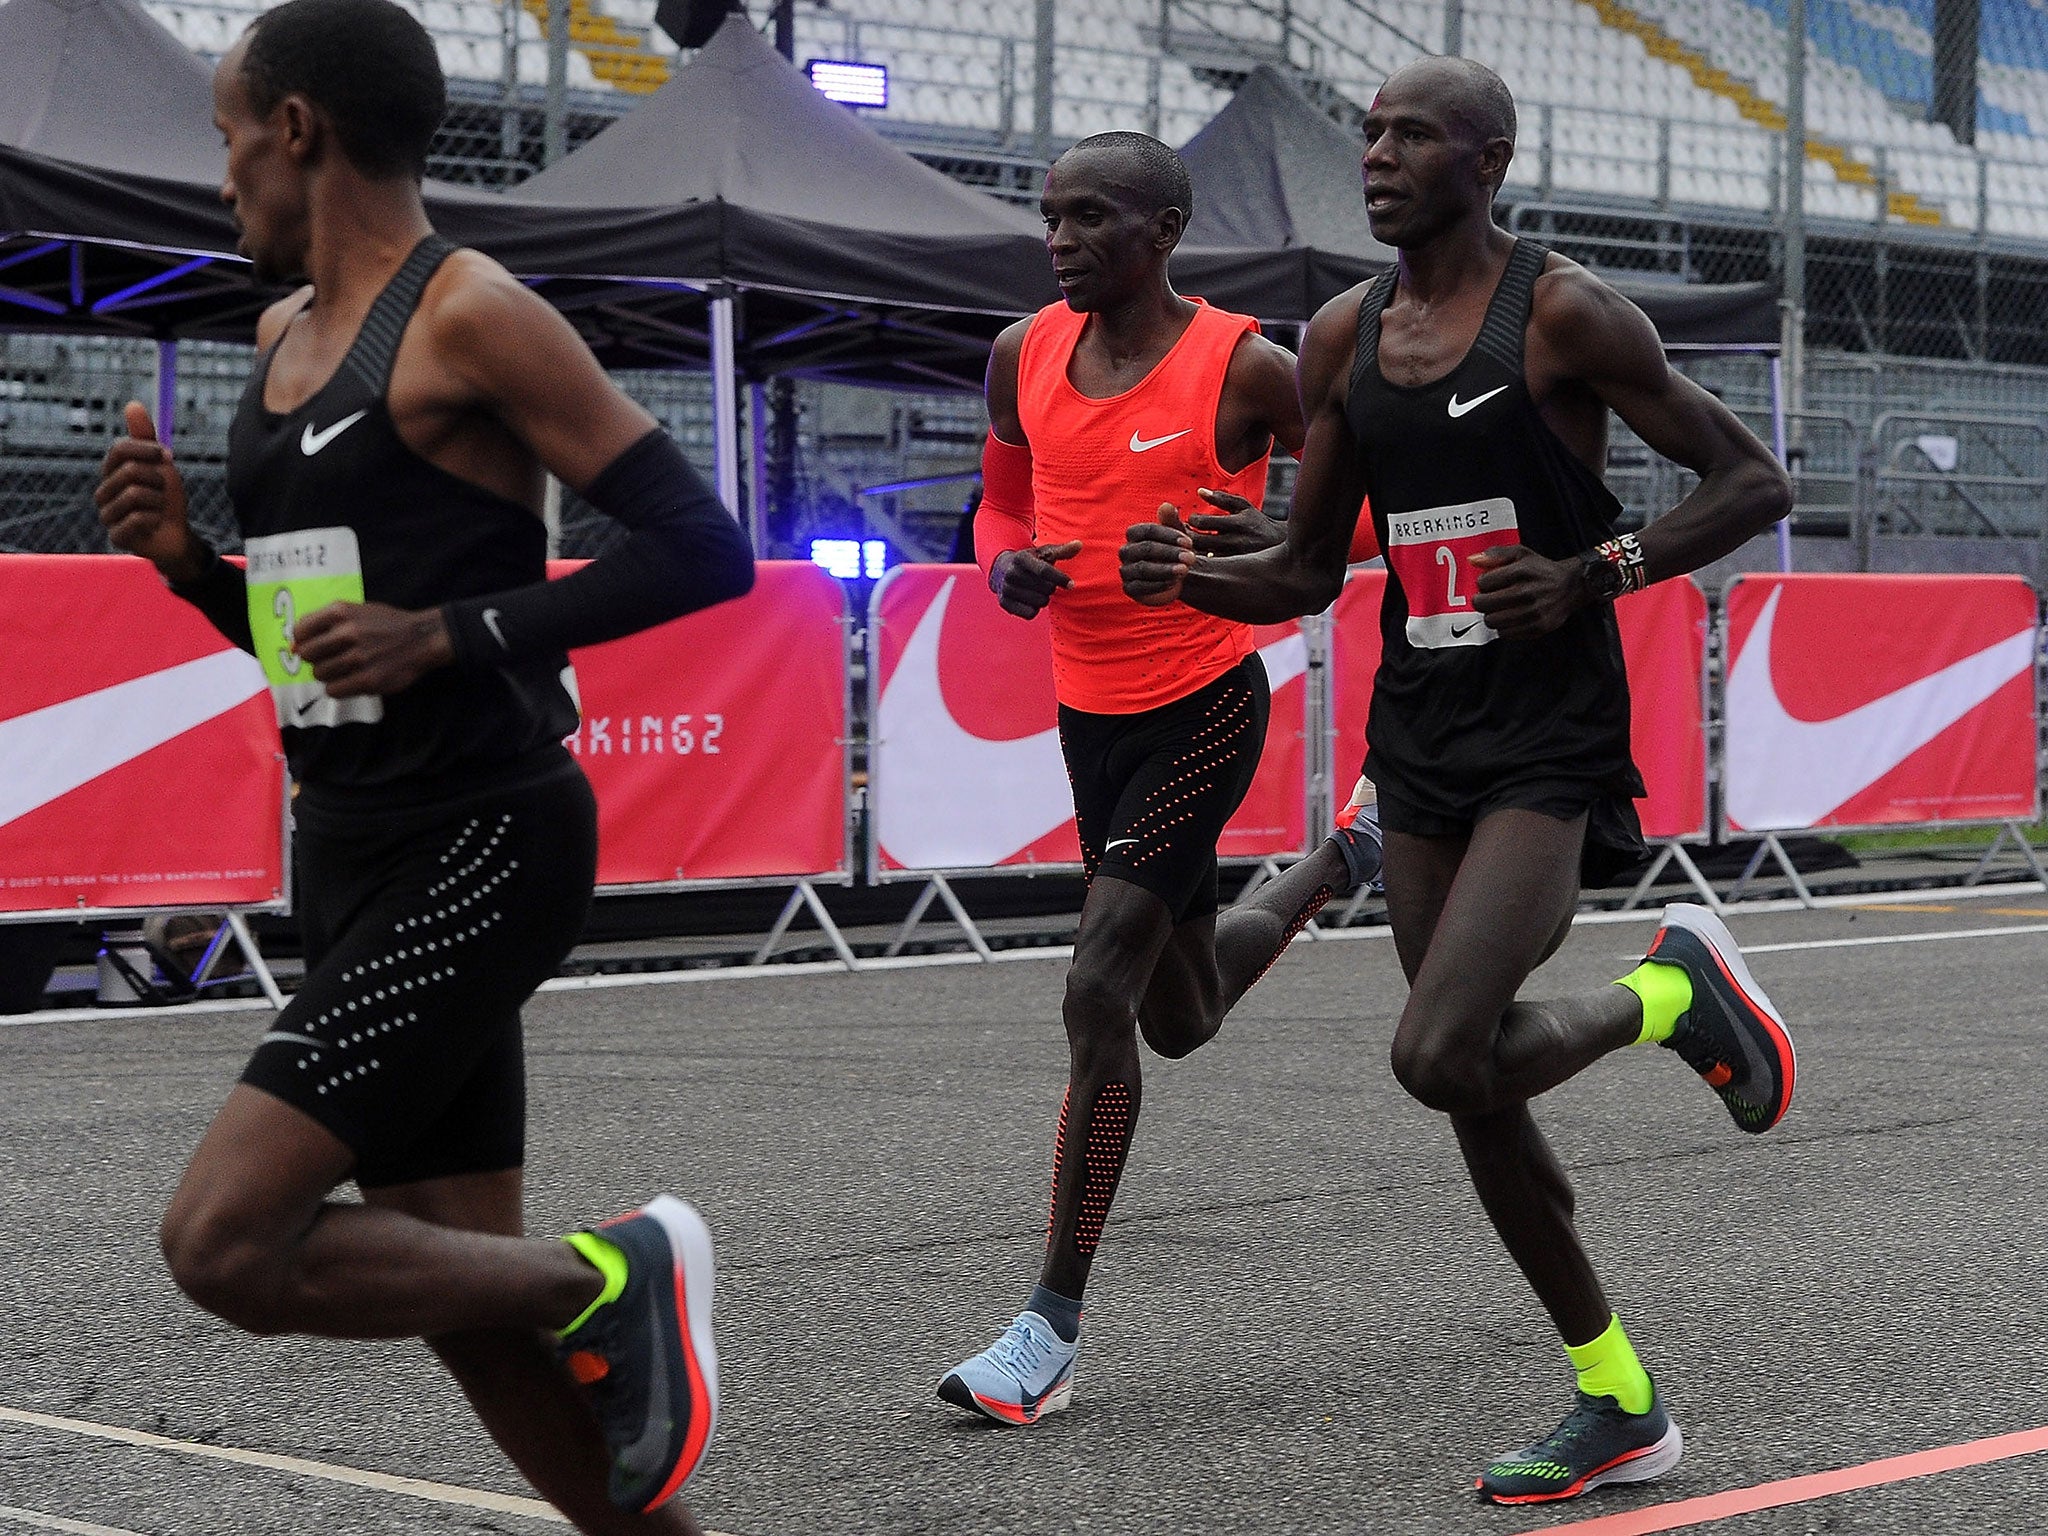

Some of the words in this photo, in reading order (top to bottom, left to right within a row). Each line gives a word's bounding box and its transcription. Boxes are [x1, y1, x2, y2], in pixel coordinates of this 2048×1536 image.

[1395, 511, 1490, 537] BREAKING2
[1435, 546, 1467, 607] 2
[275, 588, 300, 674] 3
